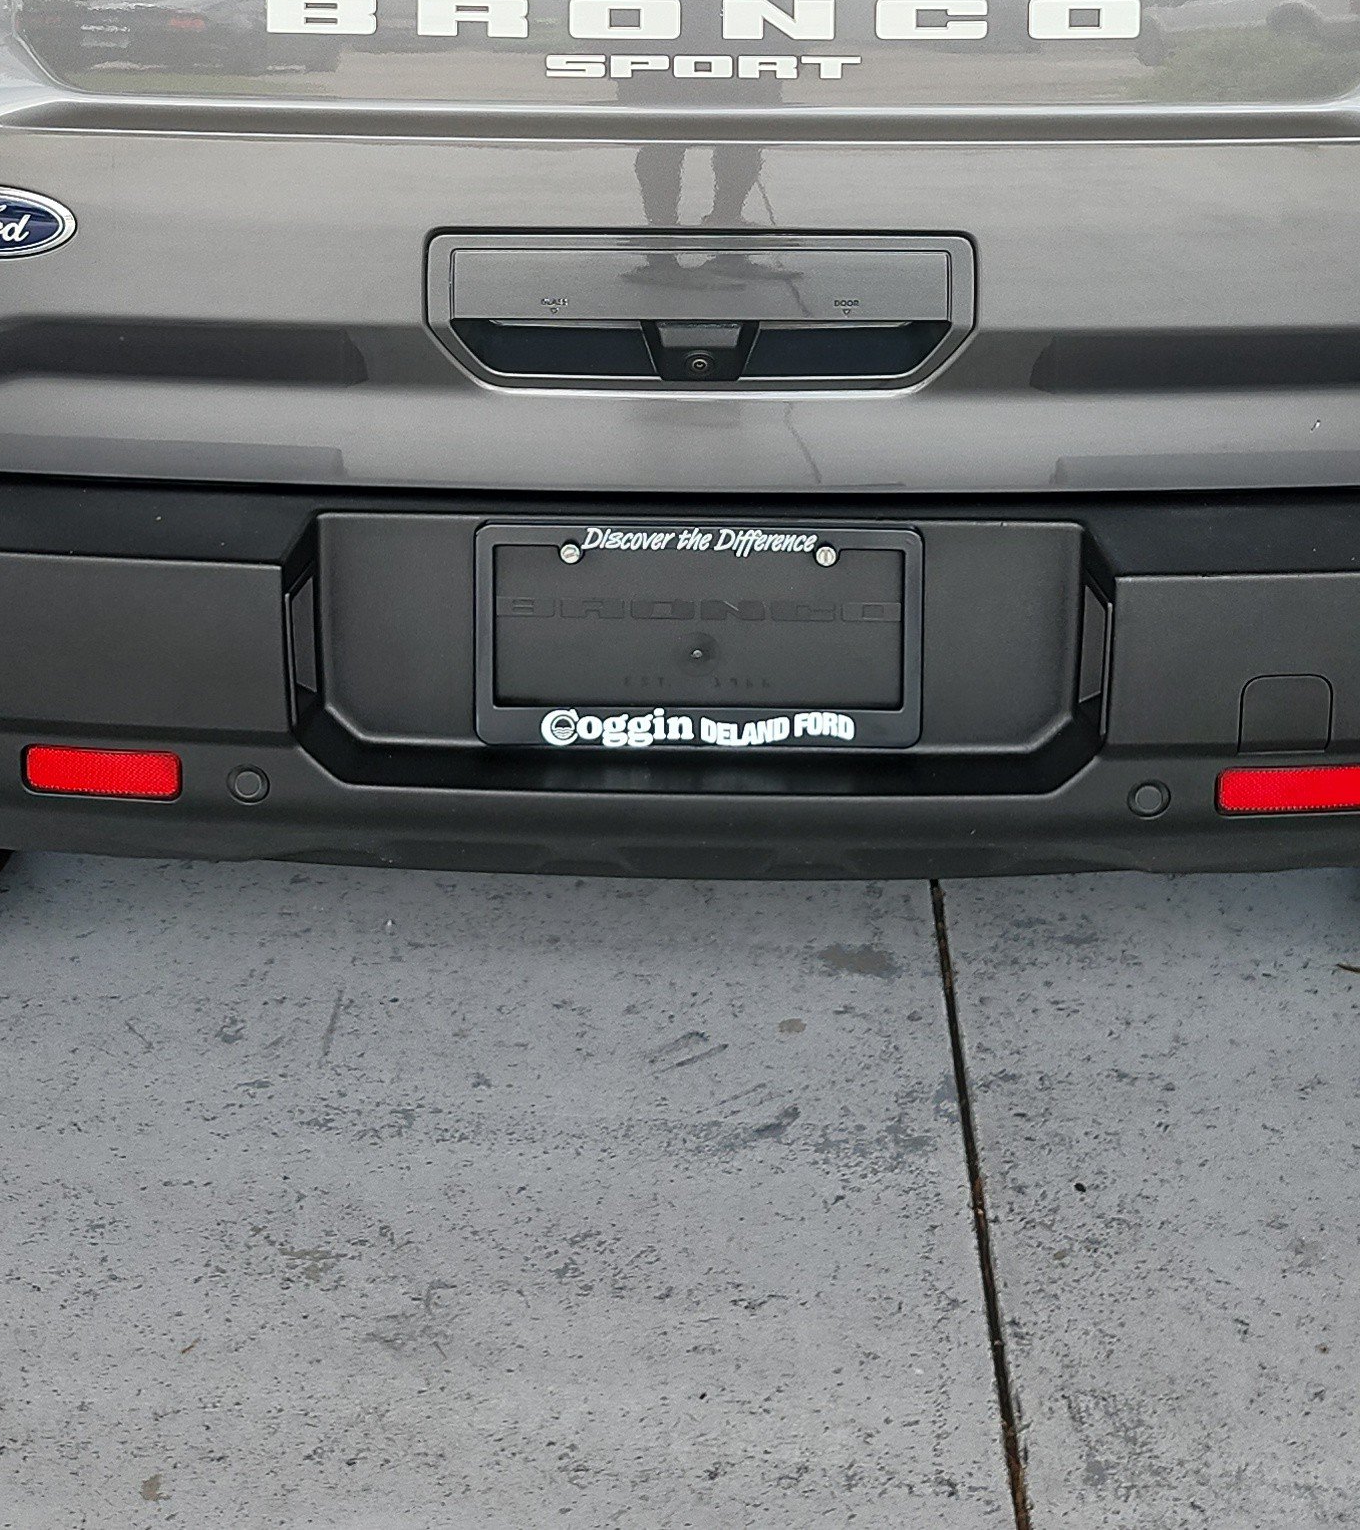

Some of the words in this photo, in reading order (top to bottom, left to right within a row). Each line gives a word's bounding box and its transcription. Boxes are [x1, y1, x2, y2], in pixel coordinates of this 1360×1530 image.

[545, 54, 862, 80] SPORT
[833, 299, 860, 307] DOOR
[581, 527, 676, 551] Discover
[676, 527, 712, 551] the
[713, 528, 817, 558] Difference
[496, 596, 902, 622] BRONCO
[540, 707, 695, 747] Coggin
[700, 716, 790, 747] DELAND
[793, 711, 856, 741] FORD
